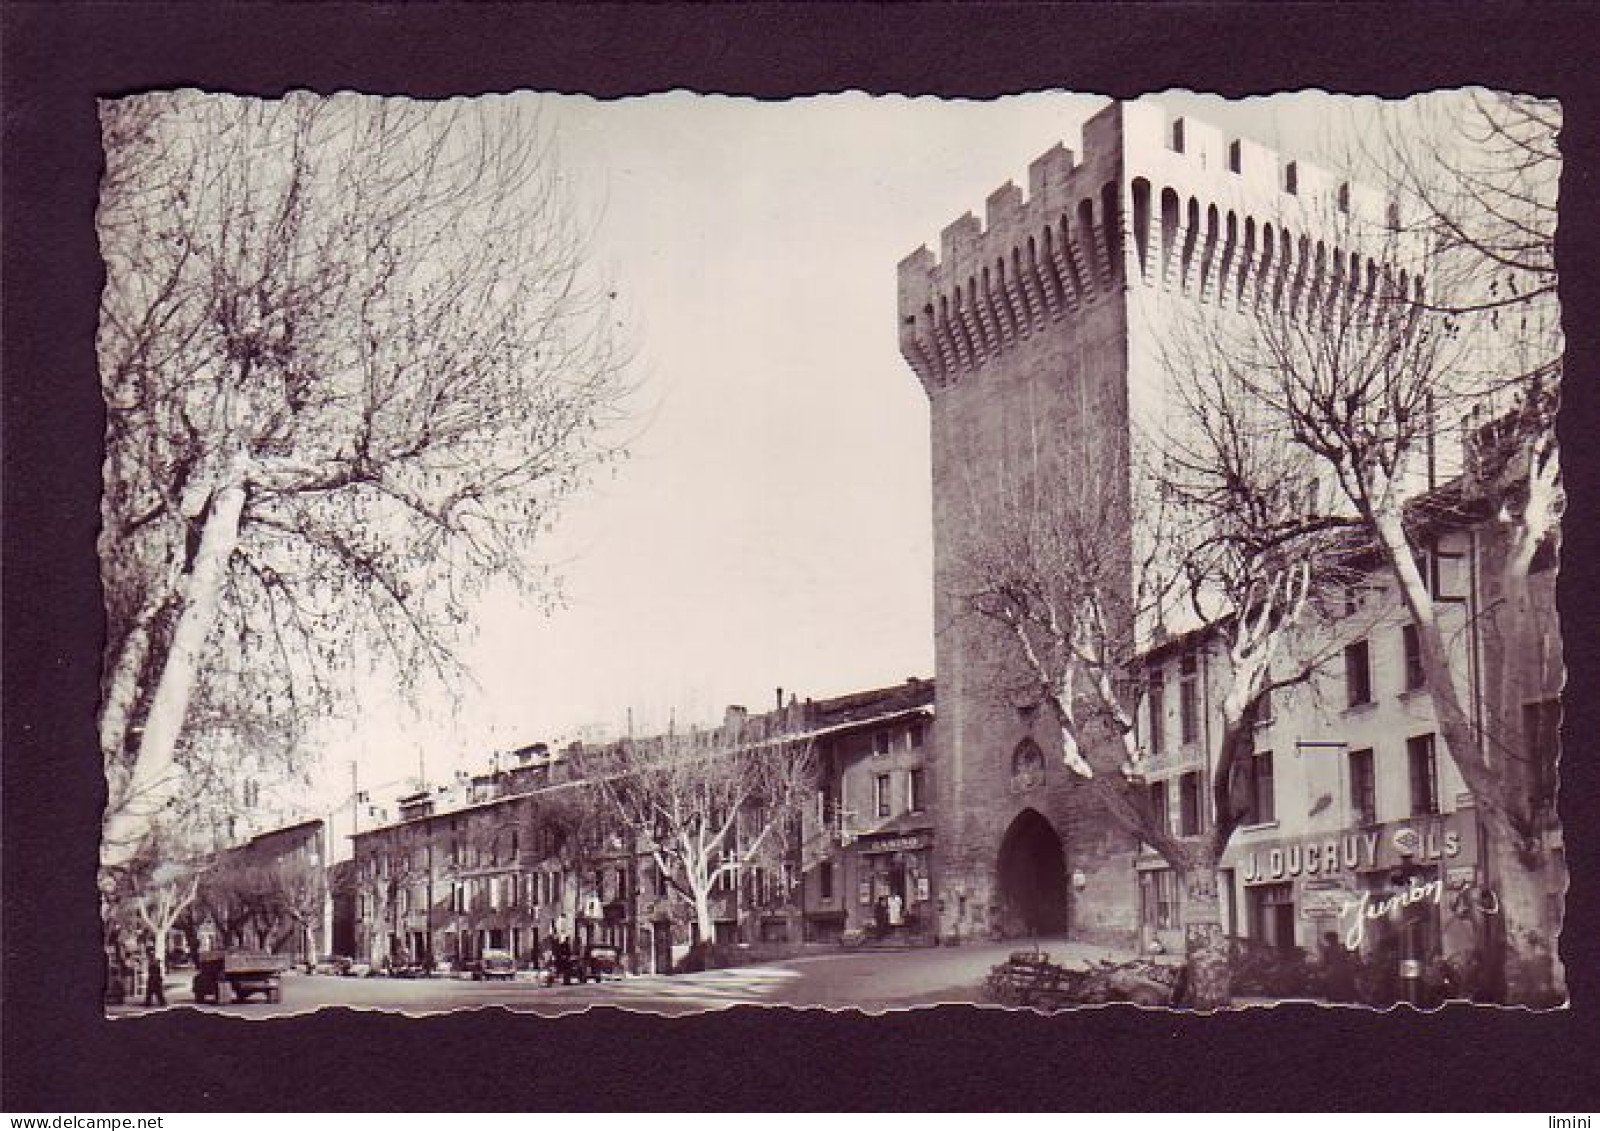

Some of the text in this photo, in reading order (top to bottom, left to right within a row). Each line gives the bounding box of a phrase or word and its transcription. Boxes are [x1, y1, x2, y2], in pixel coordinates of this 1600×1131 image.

[1245, 828, 1460, 881] J. DUCRUY ILS
